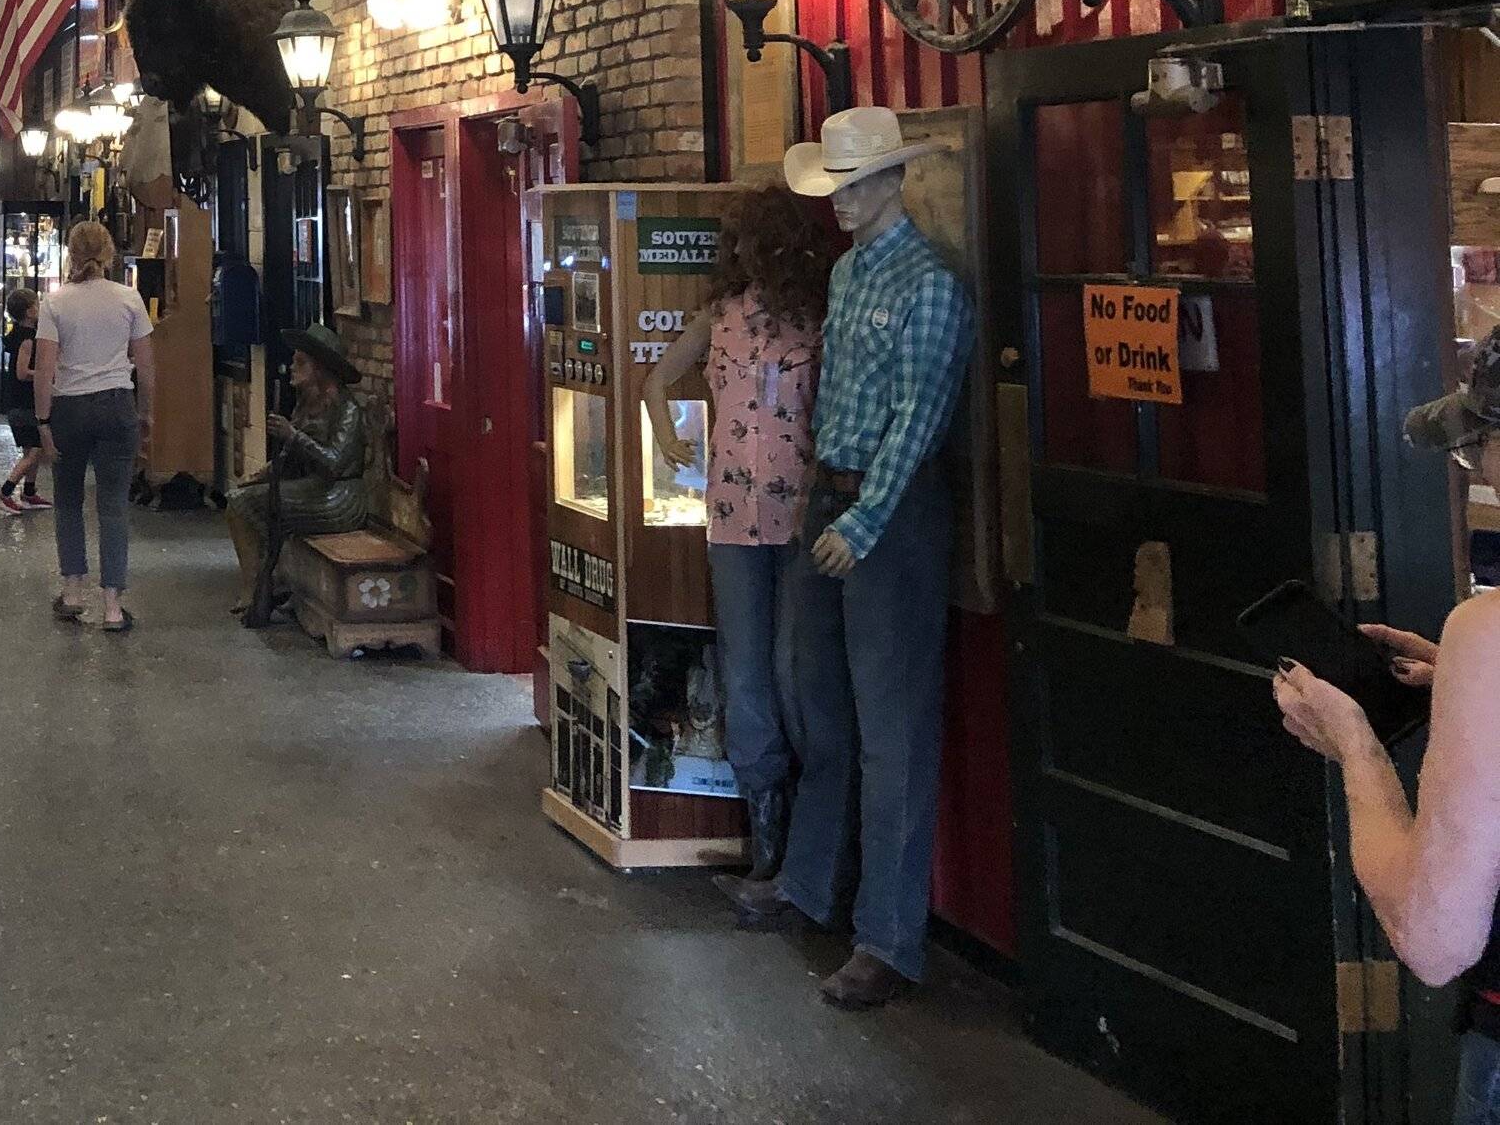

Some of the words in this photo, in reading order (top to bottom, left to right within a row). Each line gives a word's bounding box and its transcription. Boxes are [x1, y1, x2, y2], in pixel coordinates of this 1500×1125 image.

[1090, 293, 1116, 320] No
[1122, 294, 1172, 324] Food
[1094, 346, 1112, 365] or
[1118, 341, 1172, 373] Drink
[1126, 376, 1154, 393] Thank
[1155, 379, 1173, 396] You
[550, 539, 582, 584] WALL
[583, 552, 615, 599] DRUG
